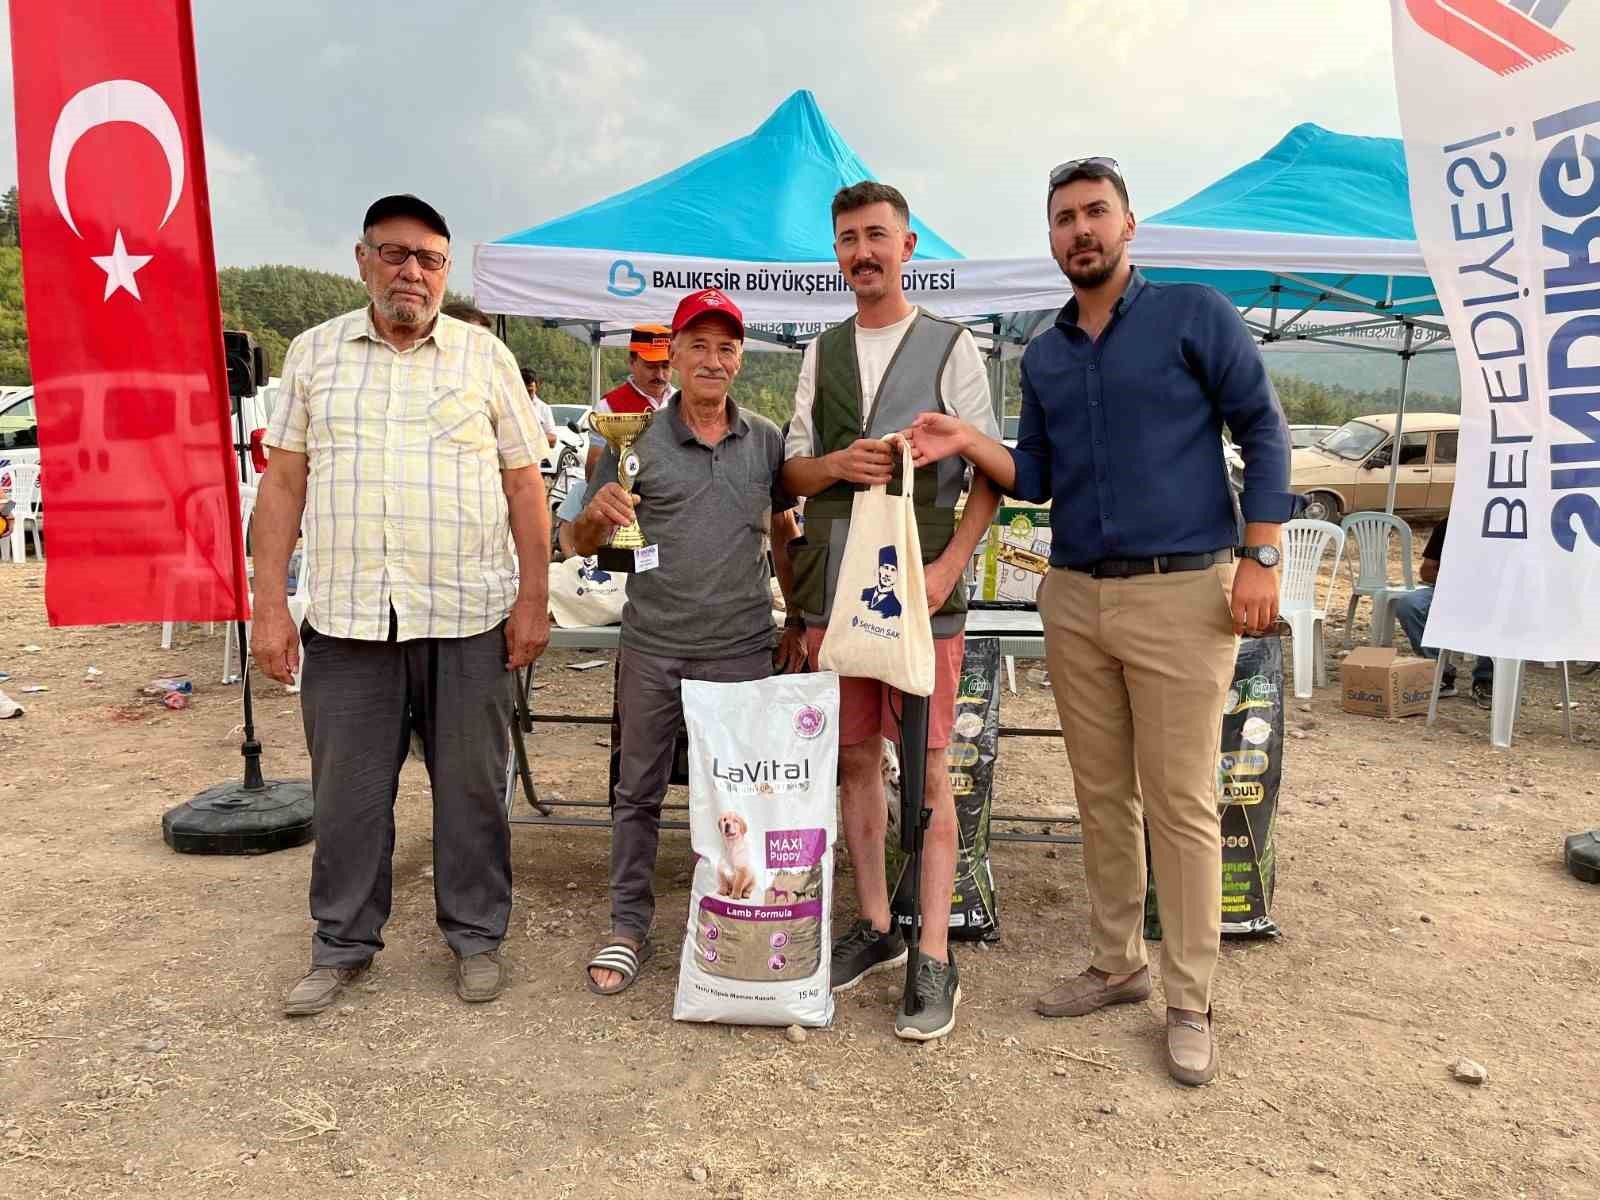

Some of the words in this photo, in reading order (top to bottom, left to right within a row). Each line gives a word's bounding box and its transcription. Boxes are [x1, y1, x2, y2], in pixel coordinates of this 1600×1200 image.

[652, 268, 741, 291] BALIKESİR
[901, 268, 956, 291] DİYESİ
[712, 757, 810, 783] LaVital
[1223, 785, 1260, 797] ADULT
[769, 837, 803, 850] MAXI
[770, 851, 800, 863] Puppy
[726, 906, 752, 918] Lamb
[754, 909, 793, 919] Formula
